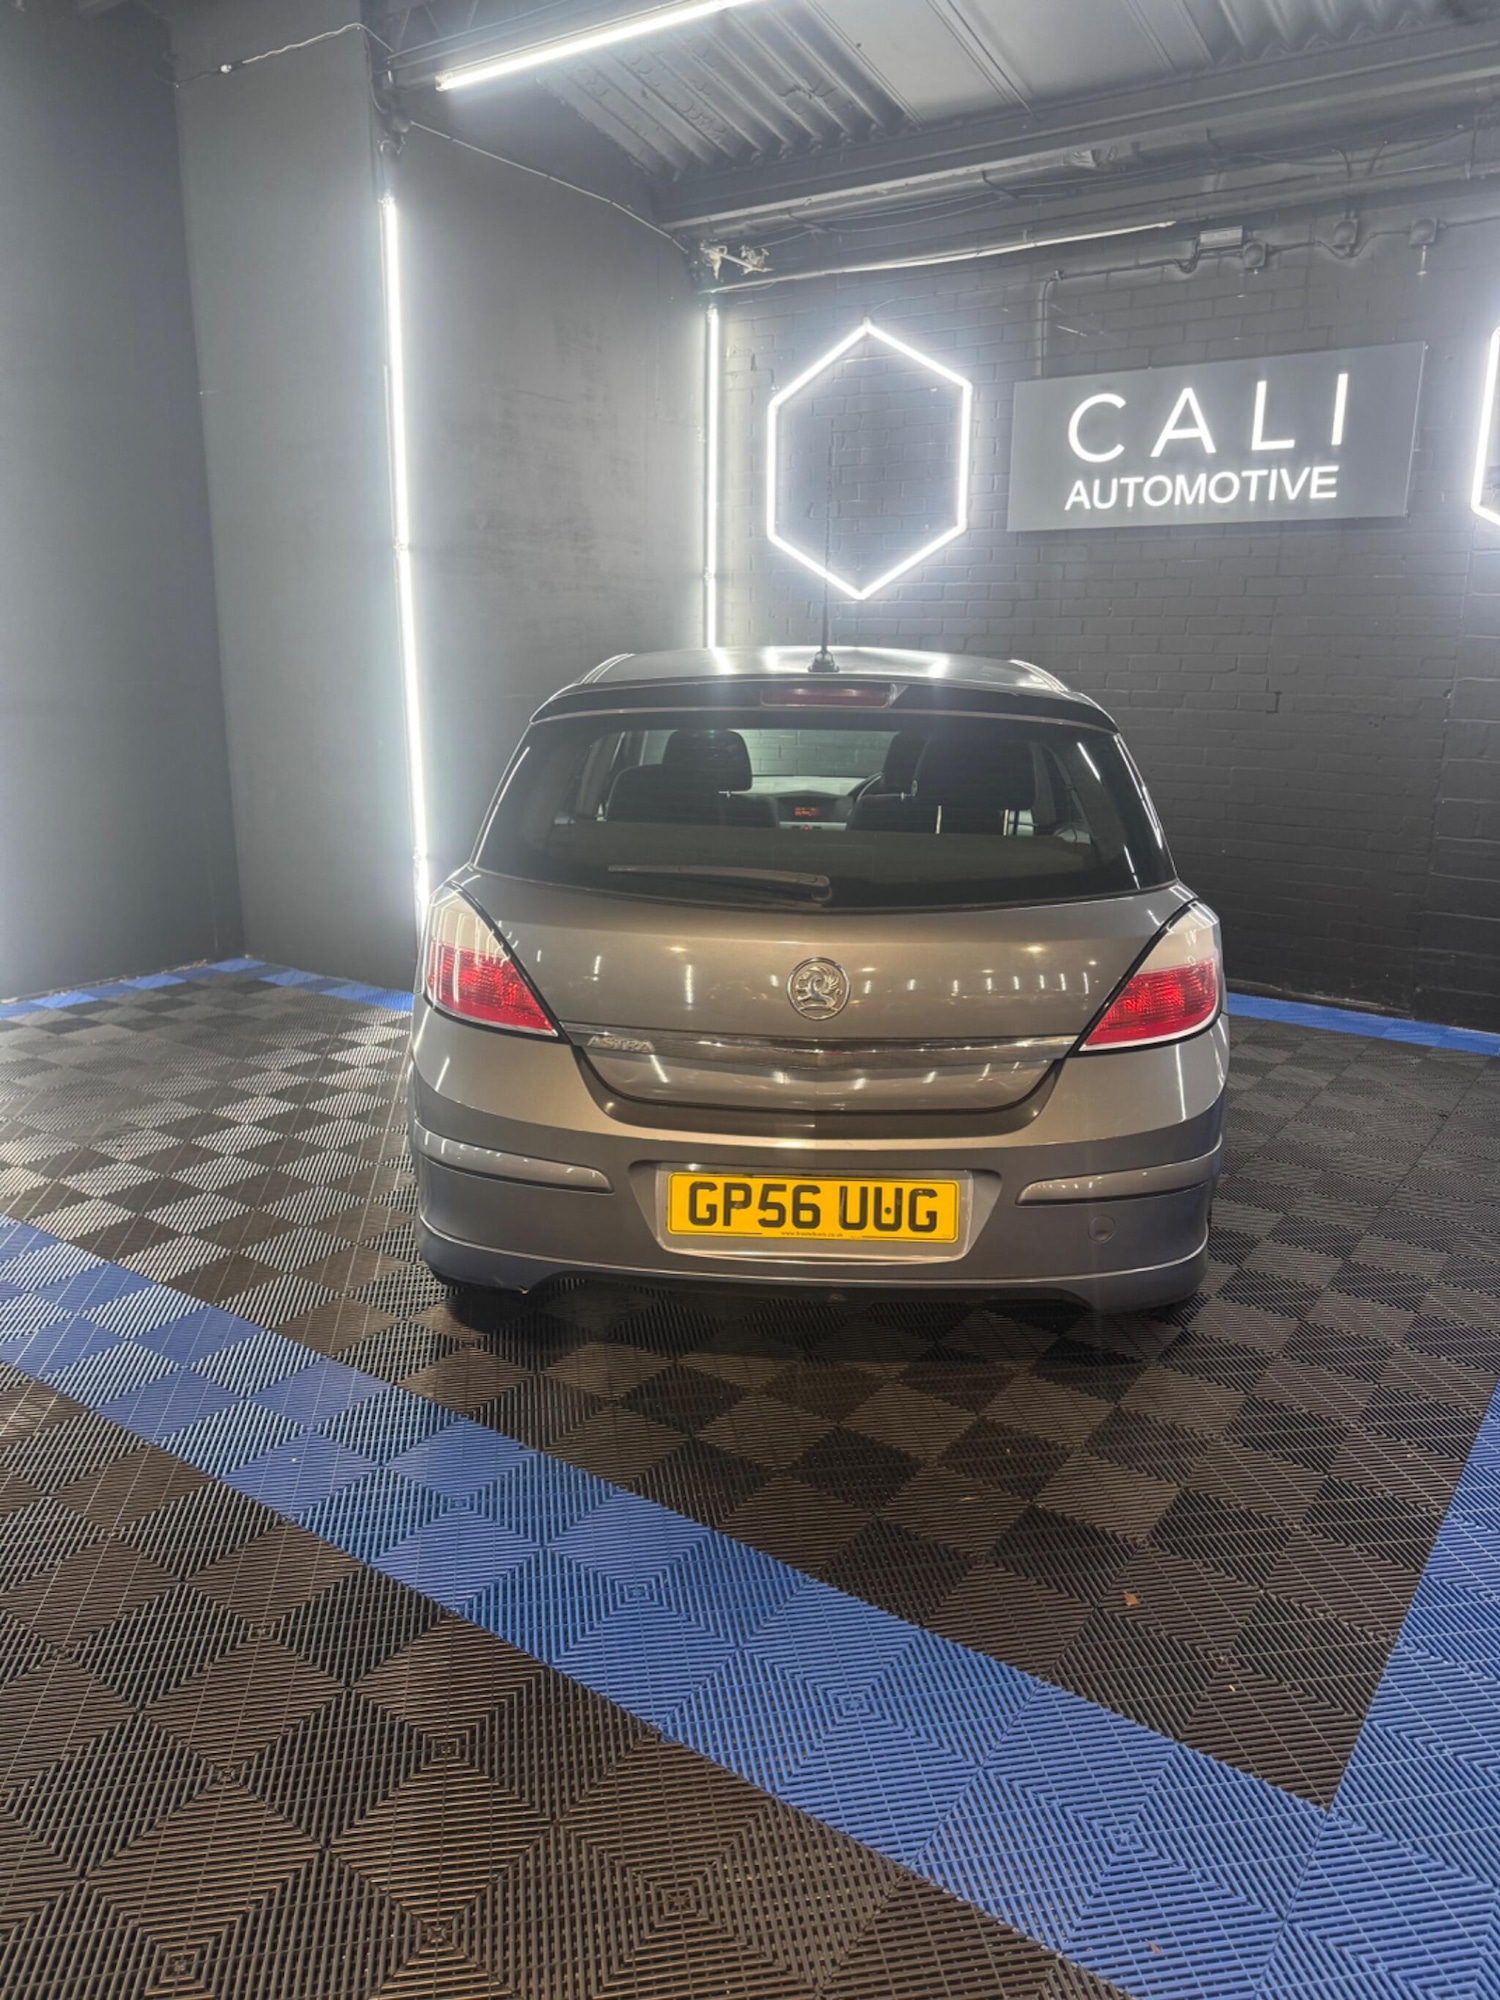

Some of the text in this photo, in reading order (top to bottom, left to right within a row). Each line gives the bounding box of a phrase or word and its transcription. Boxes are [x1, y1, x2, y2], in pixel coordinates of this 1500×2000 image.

[1068, 373, 1349, 463] CALI
[1064, 465, 1340, 511] AUTOMOTIVE
[587, 1035, 655, 1053] ASTRA
[688, 1181, 938, 1233] GP56 UUG
